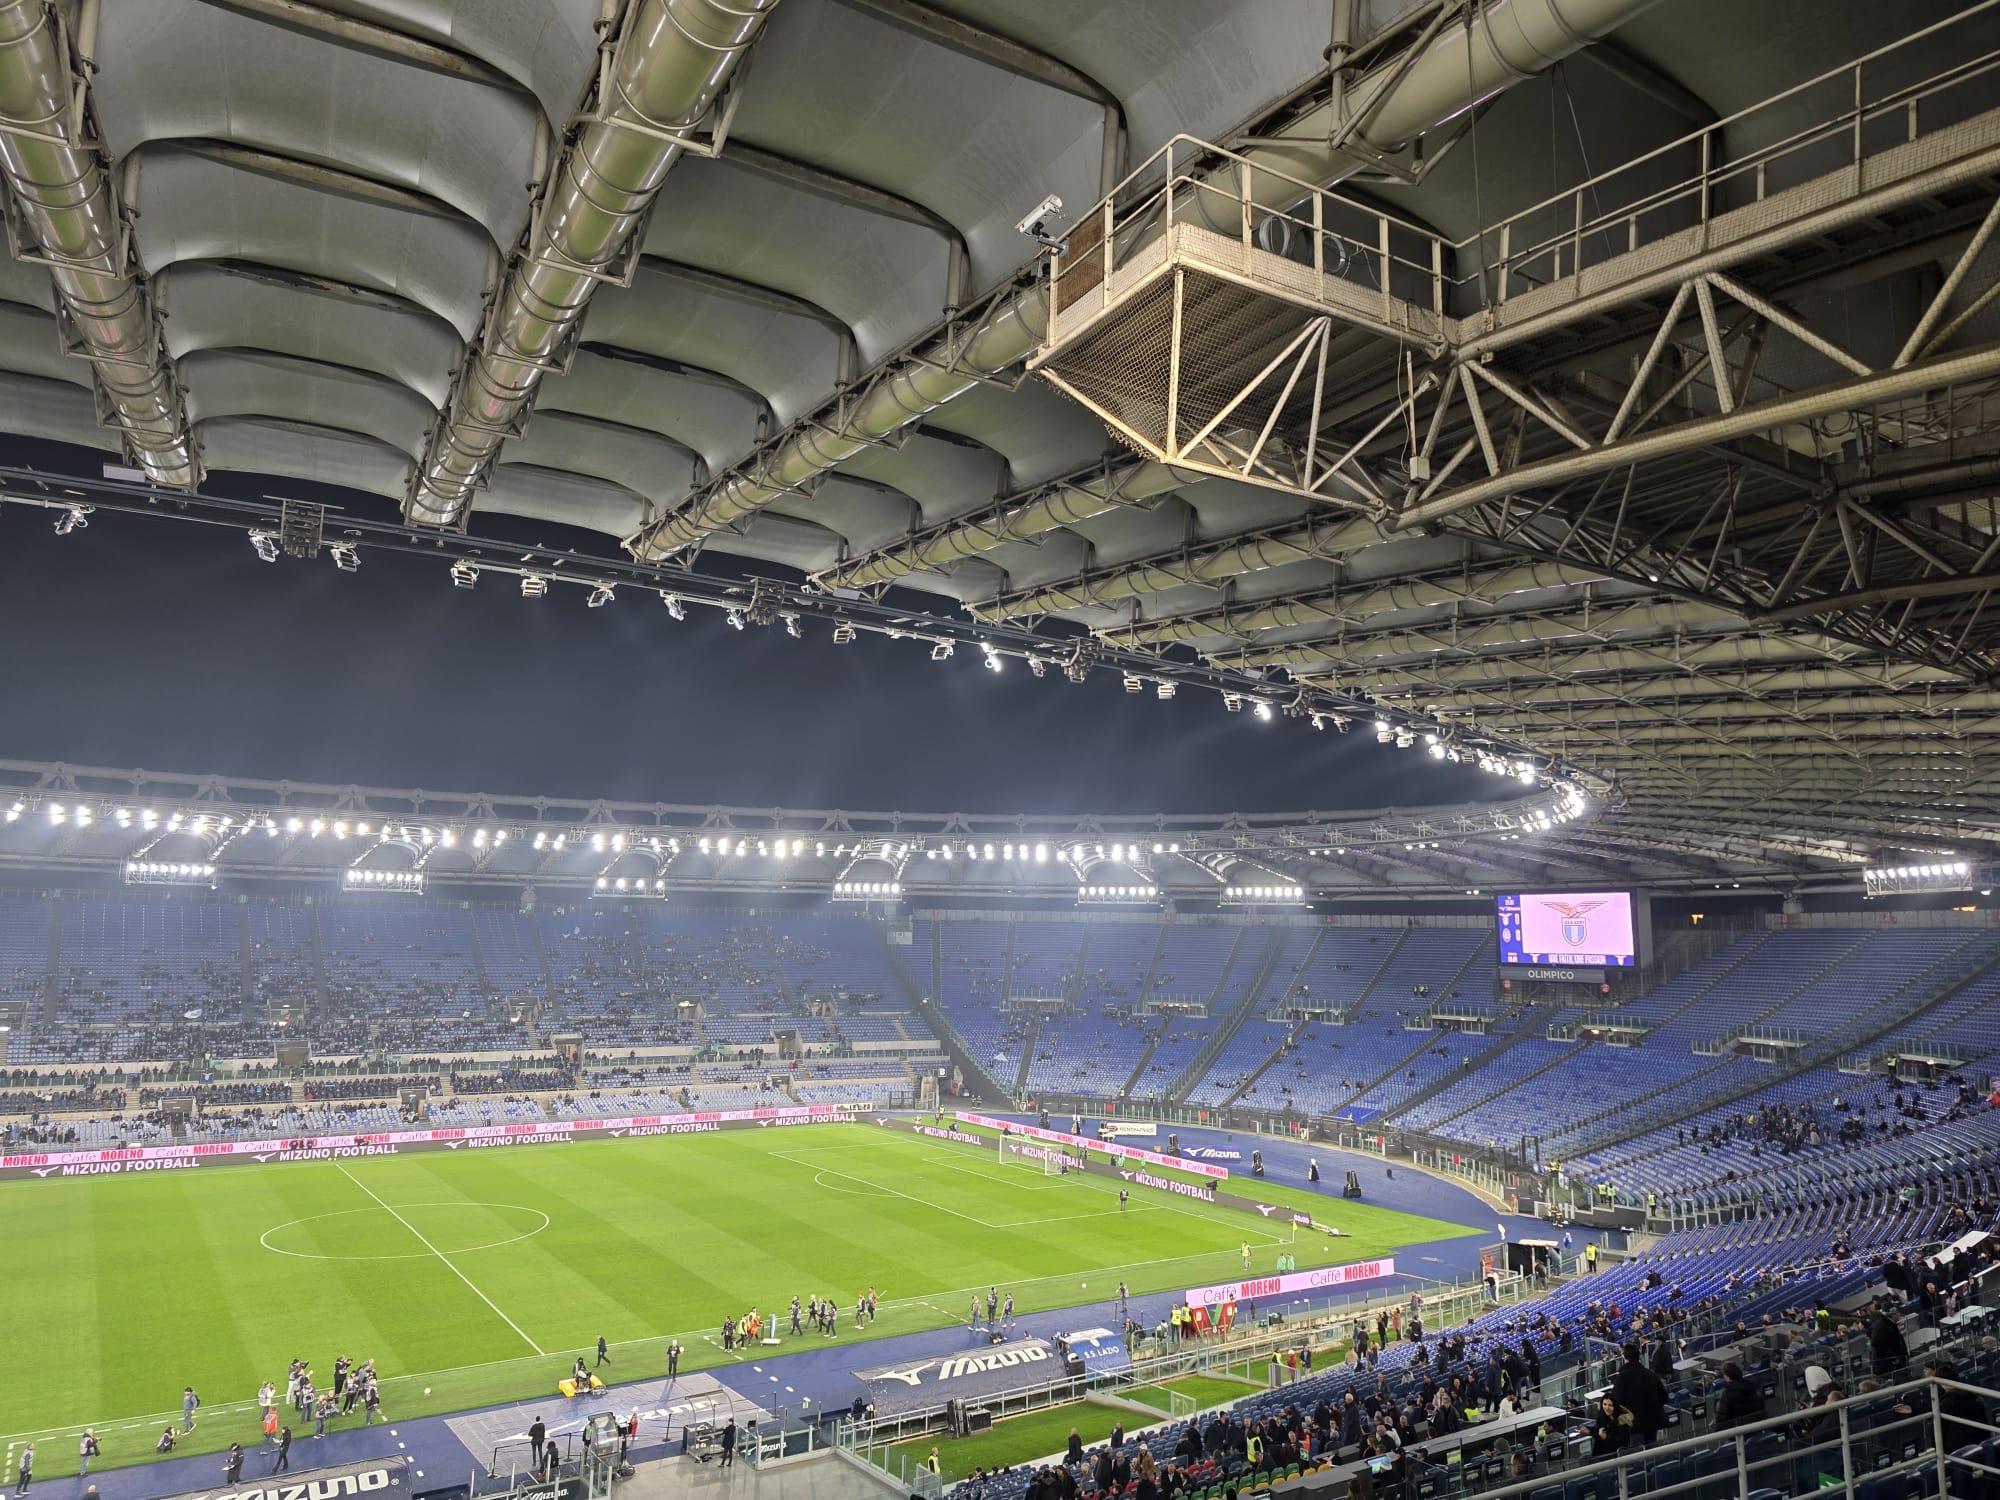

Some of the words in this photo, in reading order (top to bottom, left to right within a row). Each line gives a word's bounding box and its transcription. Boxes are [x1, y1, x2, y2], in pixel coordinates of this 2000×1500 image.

[1528, 970, 1574, 979] OLIMPICO
[776, 1115, 810, 1126] MIZUNO
[812, 1113, 856, 1124] FOOTBALL
[3, 1154, 48, 1166] MORENO
[101, 1149, 143, 1161] MORENO
[193, 1143, 233, 1154] MORENO
[432, 1129, 465, 1139] MORENO
[505, 1124, 536, 1134] MORENO
[574, 1120, 603, 1129] MORENO
[633, 1116, 660, 1126] MORENO
[695, 1112, 721, 1121] MORENO
[753, 1109, 778, 1119] MORENO
[809, 1105, 833, 1115] MORENO
[629, 1125, 668, 1136] MIZUNO
[671, 1122, 720, 1133] FOOTBALL
[924, 1127, 947, 1139] MIZUNO
[949, 1131, 981, 1145] FOOTBALL
[468, 1136, 512, 1148] MIZUNO
[516, 1132, 572, 1145] FOOTBALL
[279, 1149, 330, 1161] MIZUNO
[334, 1144, 398, 1157] FOOTBALL
[1022, 1146, 1047, 1160] MIZUNO
[63, 1162, 121, 1176] MIZUNO
[126, 1157, 200, 1172] FOOTBALL
[1136, 1173, 1167, 1189] MIZUNO
[1170, 1181, 1214, 1202] FOOTBALL
[1203, 1286, 1237, 1304] Caffè
[1241, 1279, 1280, 1298] MORENO
[1310, 1270, 1341, 1286] Caffè
[1345, 1263, 1380, 1281] MORENO
[1097, 1346, 1119, 1357] LAZIO
